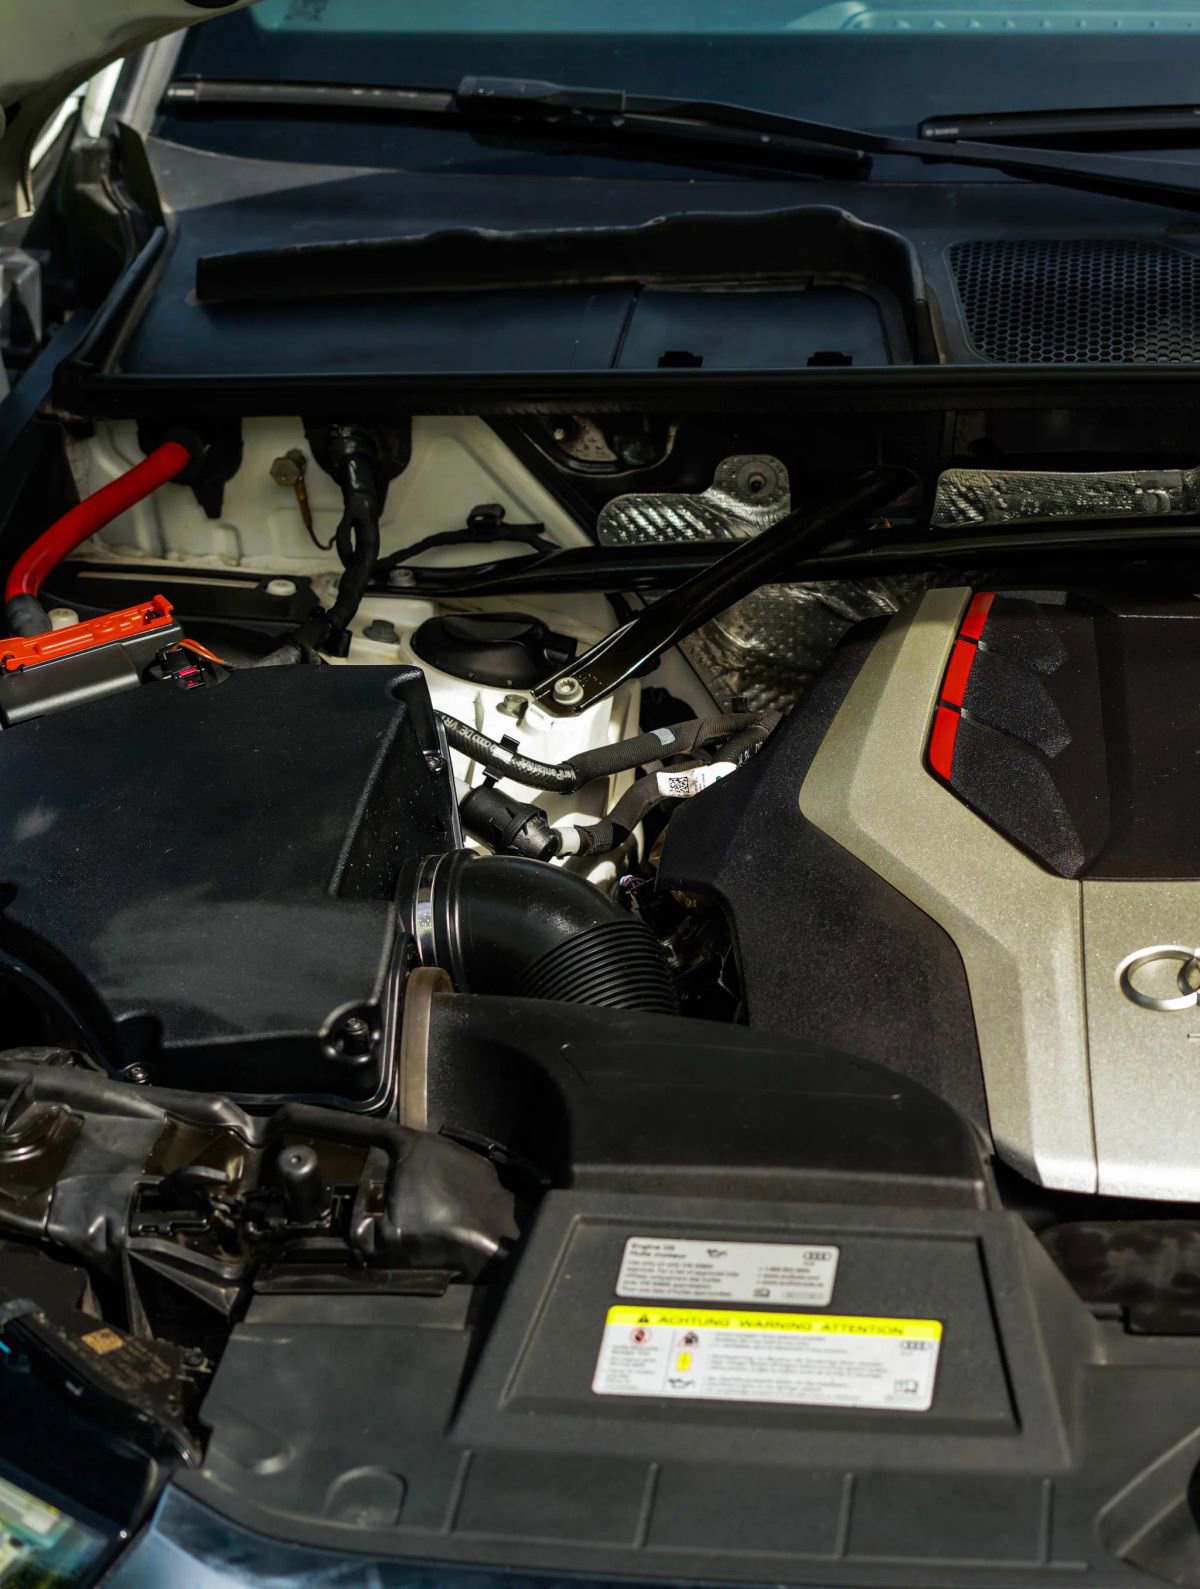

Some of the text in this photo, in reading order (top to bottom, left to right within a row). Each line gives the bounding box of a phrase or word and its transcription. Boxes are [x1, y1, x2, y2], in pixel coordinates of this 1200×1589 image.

[657, 1316, 904, 1335] ACHTUNG WARNING ATTENTION
